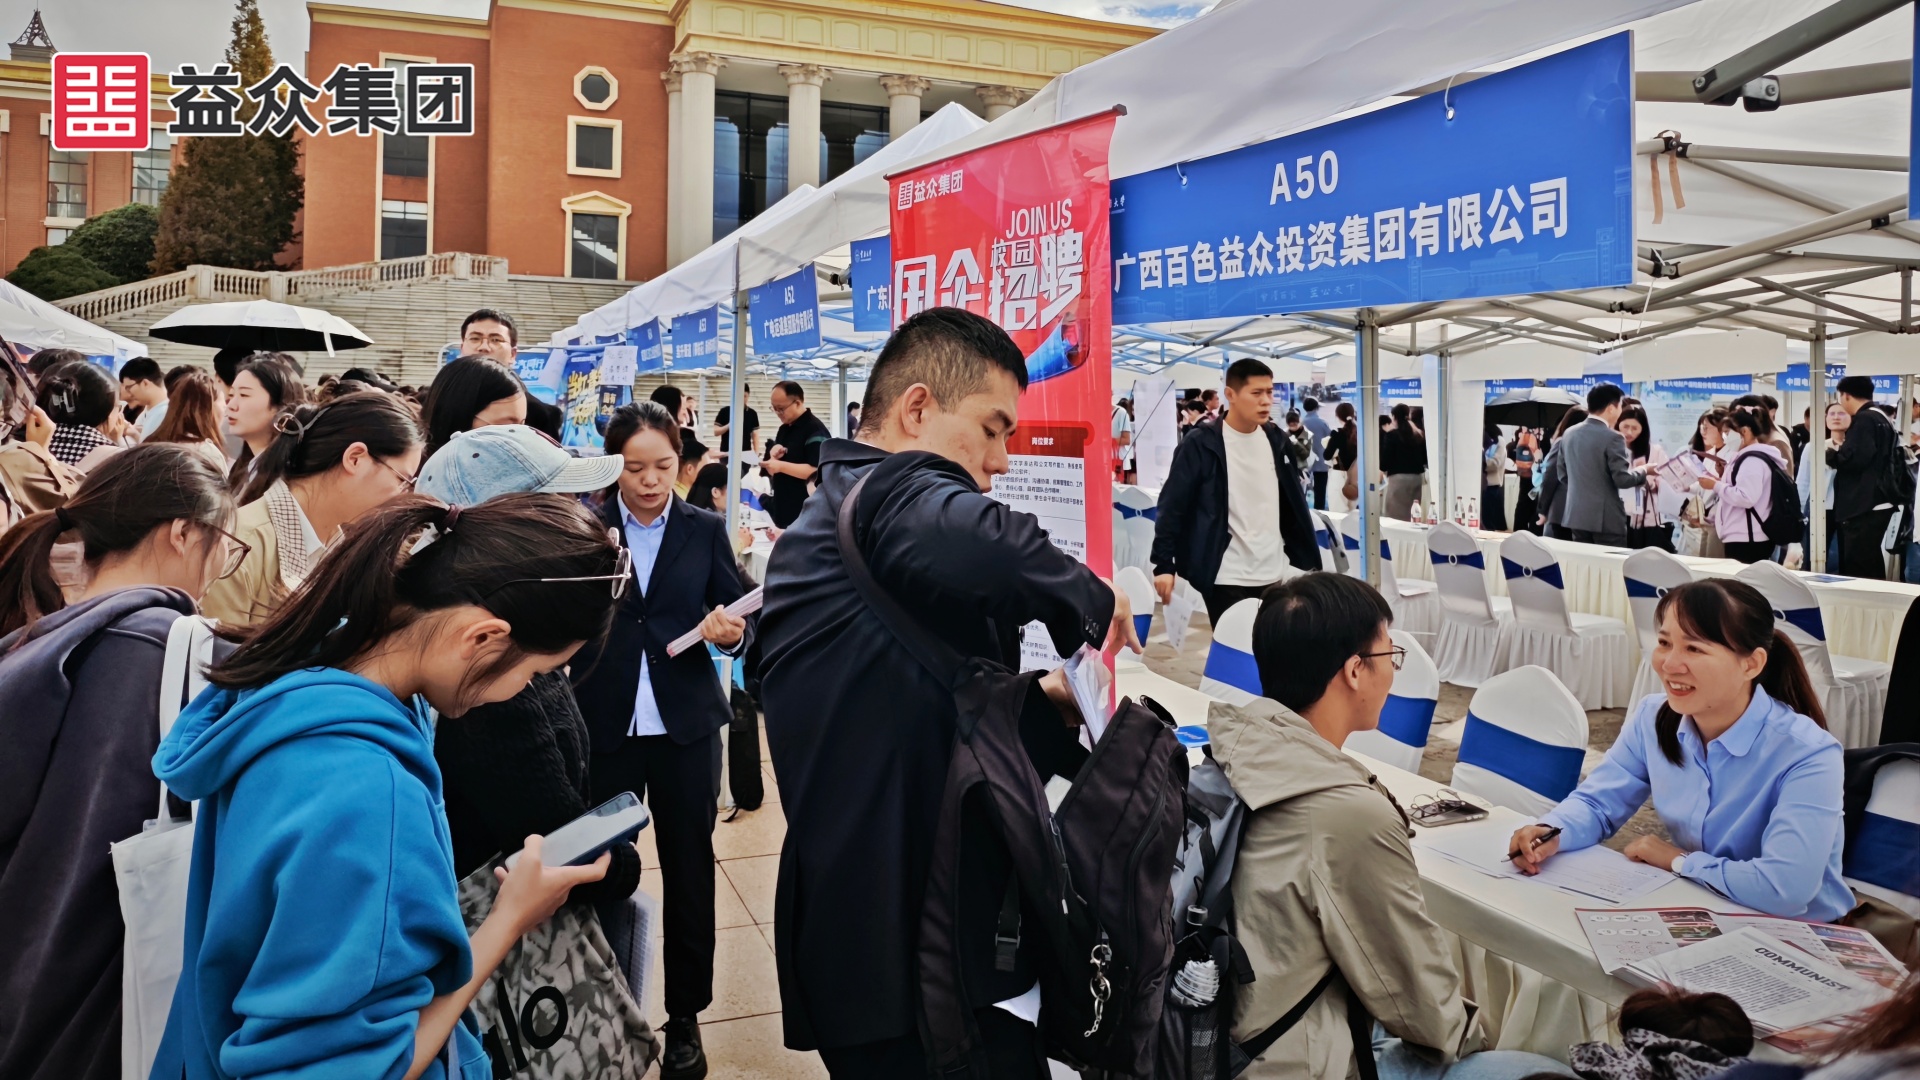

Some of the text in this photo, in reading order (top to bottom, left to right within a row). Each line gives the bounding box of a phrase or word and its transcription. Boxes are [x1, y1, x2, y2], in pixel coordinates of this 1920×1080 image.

[914, 169, 963, 203] 益众集团
[1269, 149, 1340, 205] A50
[1006, 198, 1073, 239] JOIN US
[1114, 176, 1569, 293] 广西百色益众投资集团有限公司
[990, 237, 1035, 269] 校园
[784, 285, 796, 306] A52
[988, 228, 1084, 331] 招聘
[1830, 367, 1847, 377] A23
[1031, 437, 1054, 446] 岗位要求
[1754, 945, 1852, 992] COMMUNIST
